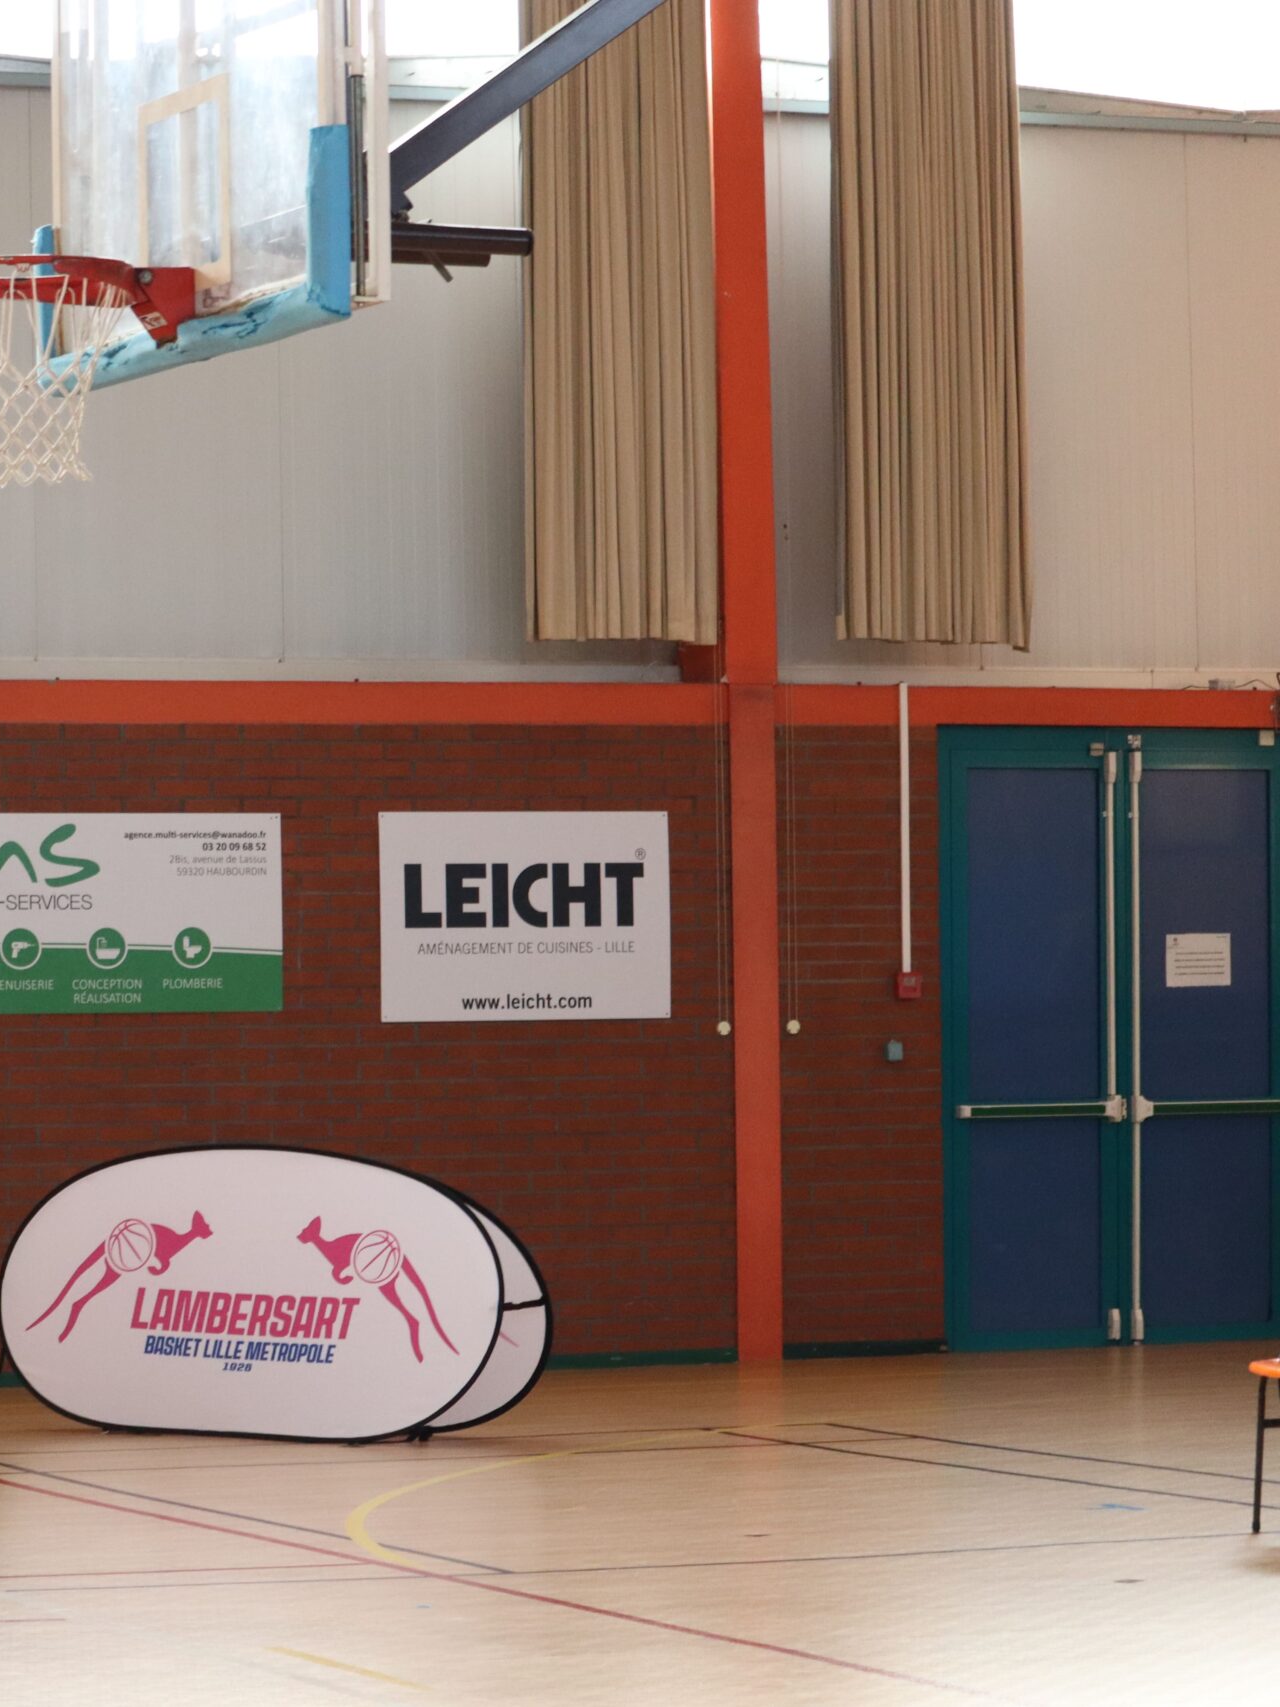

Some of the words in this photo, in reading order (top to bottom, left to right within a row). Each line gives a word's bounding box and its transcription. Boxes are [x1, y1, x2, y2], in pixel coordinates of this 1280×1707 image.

[123, 830, 267, 841] agence.multi-services@wanadoo.fr
[202, 842, 214, 851] 03
[215, 842, 227, 851] 20
[228, 842, 240, 851] 09
[242, 842, 254, 851] 68
[255, 842, 267, 851] 52
[191, 856, 224, 864] avenue
[225, 854, 237, 864] de
[176, 866, 205, 876] 59320
[206, 866, 268, 876] HAUBOURDIN
[417, 941, 514, 956] AMÉNAGEMENT
[517, 942, 534, 954] DE
[536, 941, 594, 954] CUISINES
[604, 940, 635, 953] LILLE
[72, 978, 143, 990] CONCEPTION
[162, 977, 223, 989] PLOMBERIE
[73, 992, 142, 1004] RÉALISATION
[461, 993, 593, 1010] www.leicht.com
[130, 1287, 361, 1340] LAMBERSART
[144, 1335, 202, 1357] BASKET
[203, 1339, 245, 1360] LILLE
[245, 1341, 336, 1364] METROPOLE
